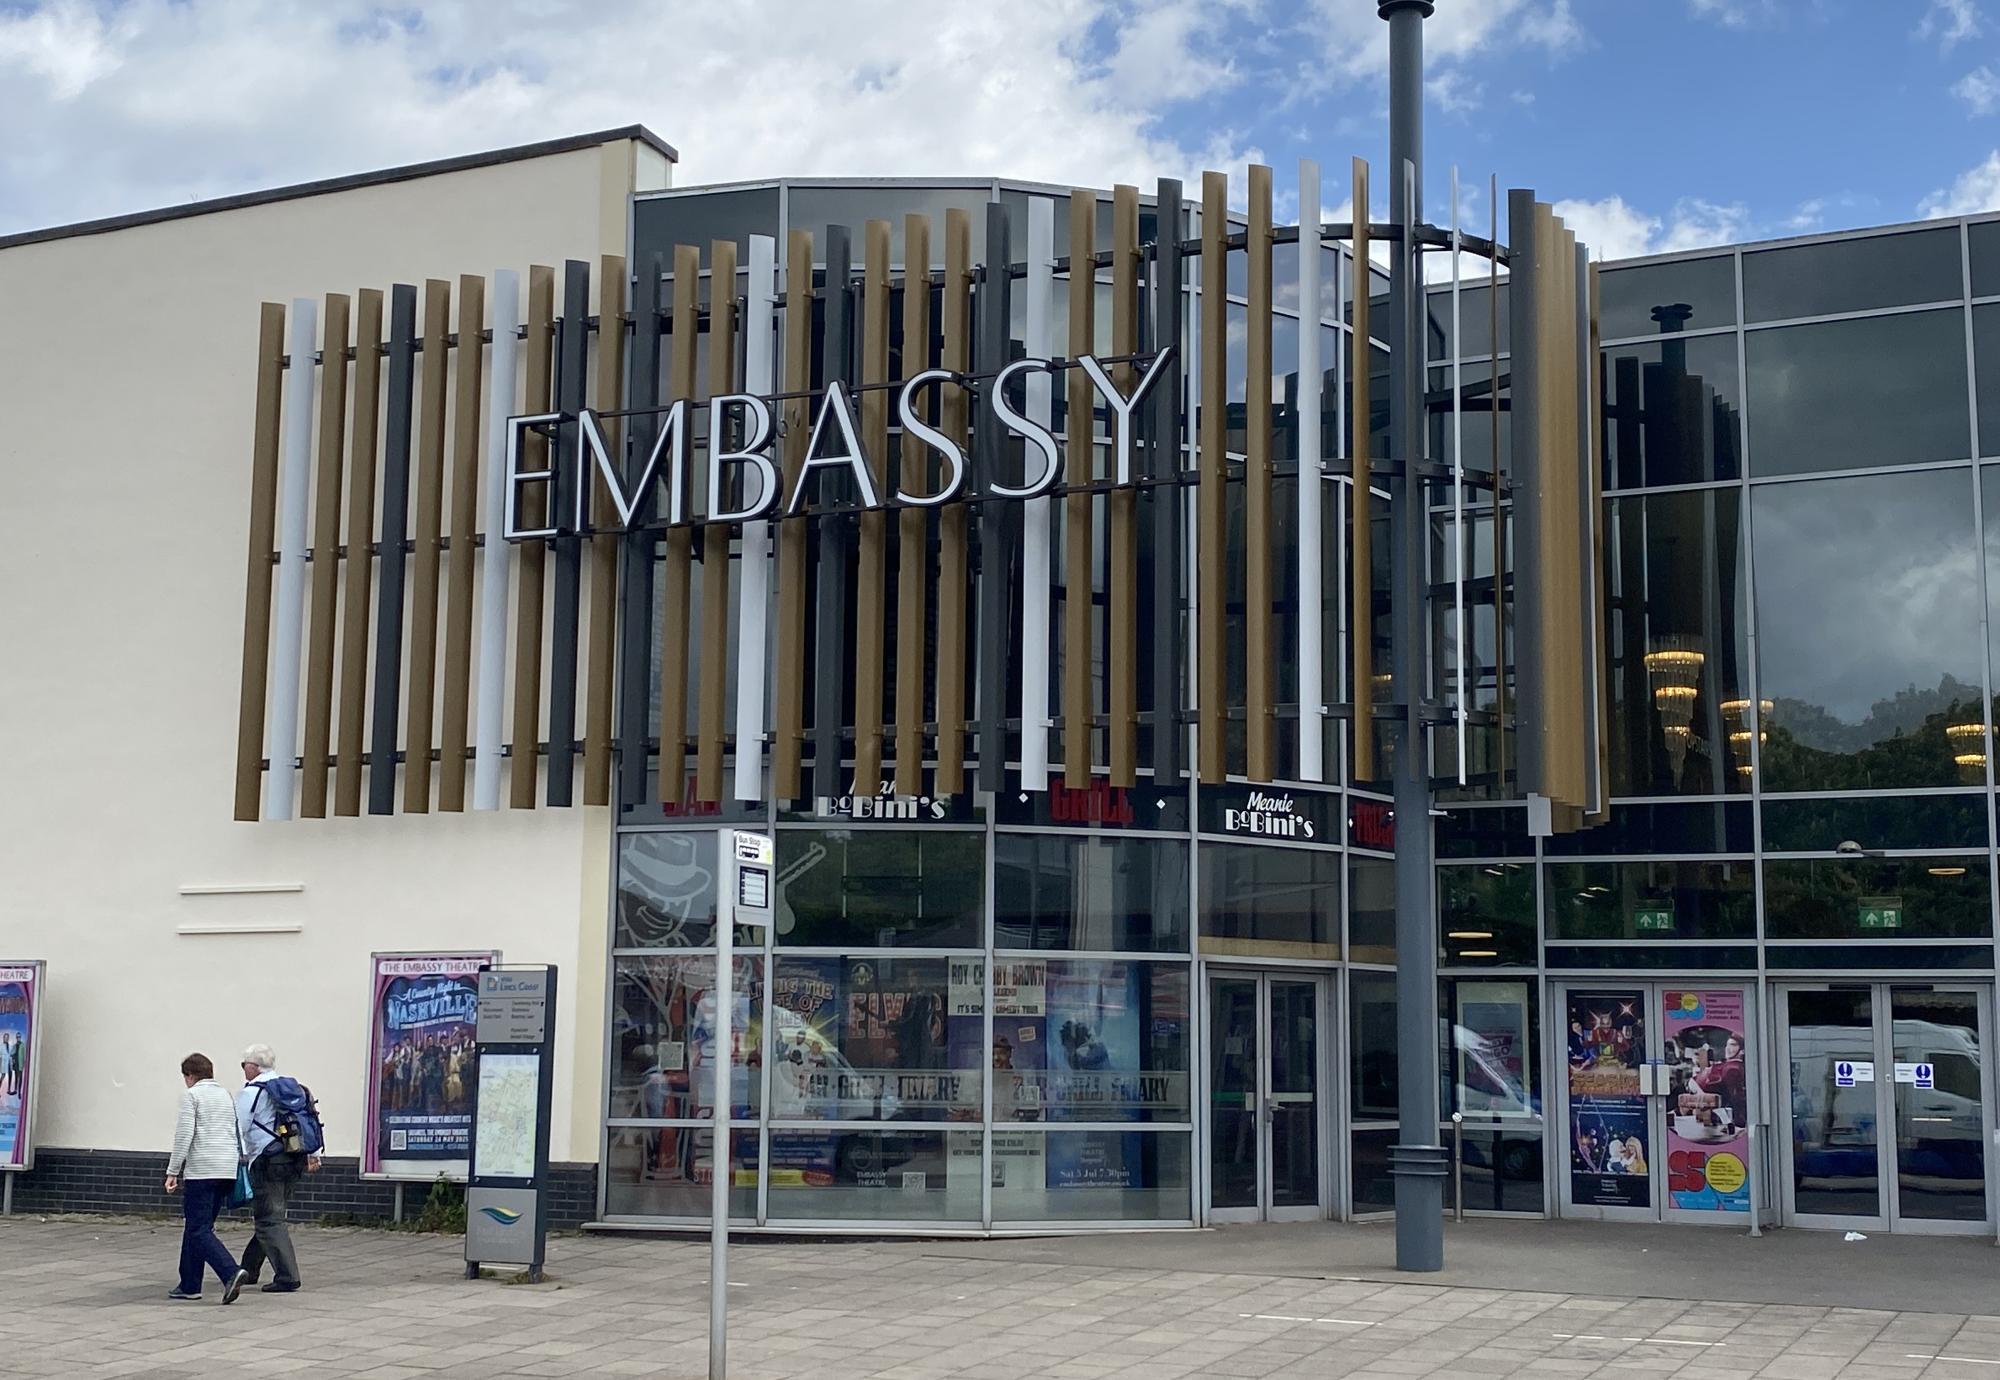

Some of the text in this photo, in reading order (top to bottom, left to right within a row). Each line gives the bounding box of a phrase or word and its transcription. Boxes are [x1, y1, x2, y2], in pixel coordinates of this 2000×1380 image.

[503, 345, 1177, 540] EMBASSY
[1246, 791, 1294, 813] Meanie
[739, 834, 761, 847] Bus Stop
[0, 970, 29, 980] HEATRE
[384, 963, 400, 973] THE
[403, 962, 442, 972] EMBASSY
[951, 964, 1044, 986] ROY CHBY BROWN
[387, 992, 478, 1030] NASHVILLE
[848, 992, 942, 1040] ELVS
